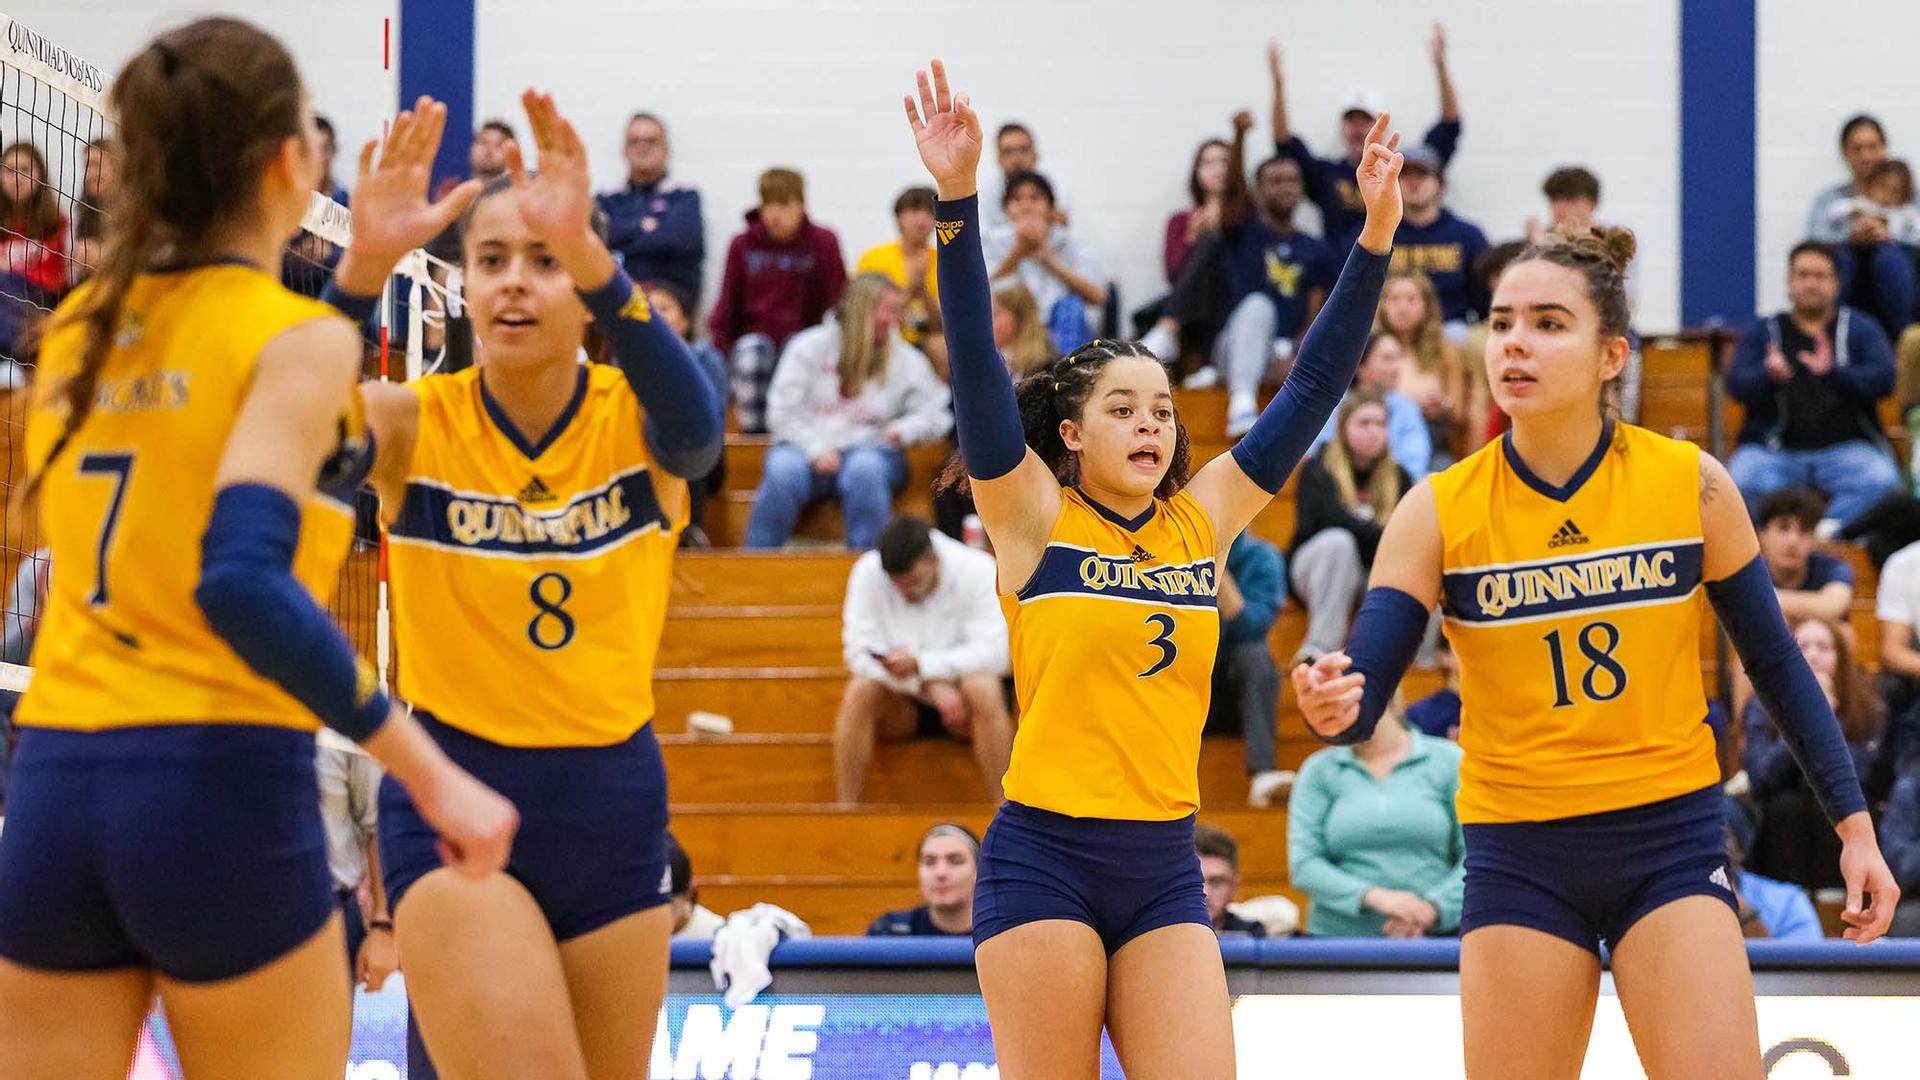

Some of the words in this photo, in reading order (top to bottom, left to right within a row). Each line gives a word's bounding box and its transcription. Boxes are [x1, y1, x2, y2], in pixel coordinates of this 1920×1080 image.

[79, 452, 136, 608] 7
[527, 571, 576, 650] 8
[1476, 551, 1677, 617] QUINNIPIAC
[1136, 612, 1178, 679] 3
[1542, 621, 1628, 708] 18
